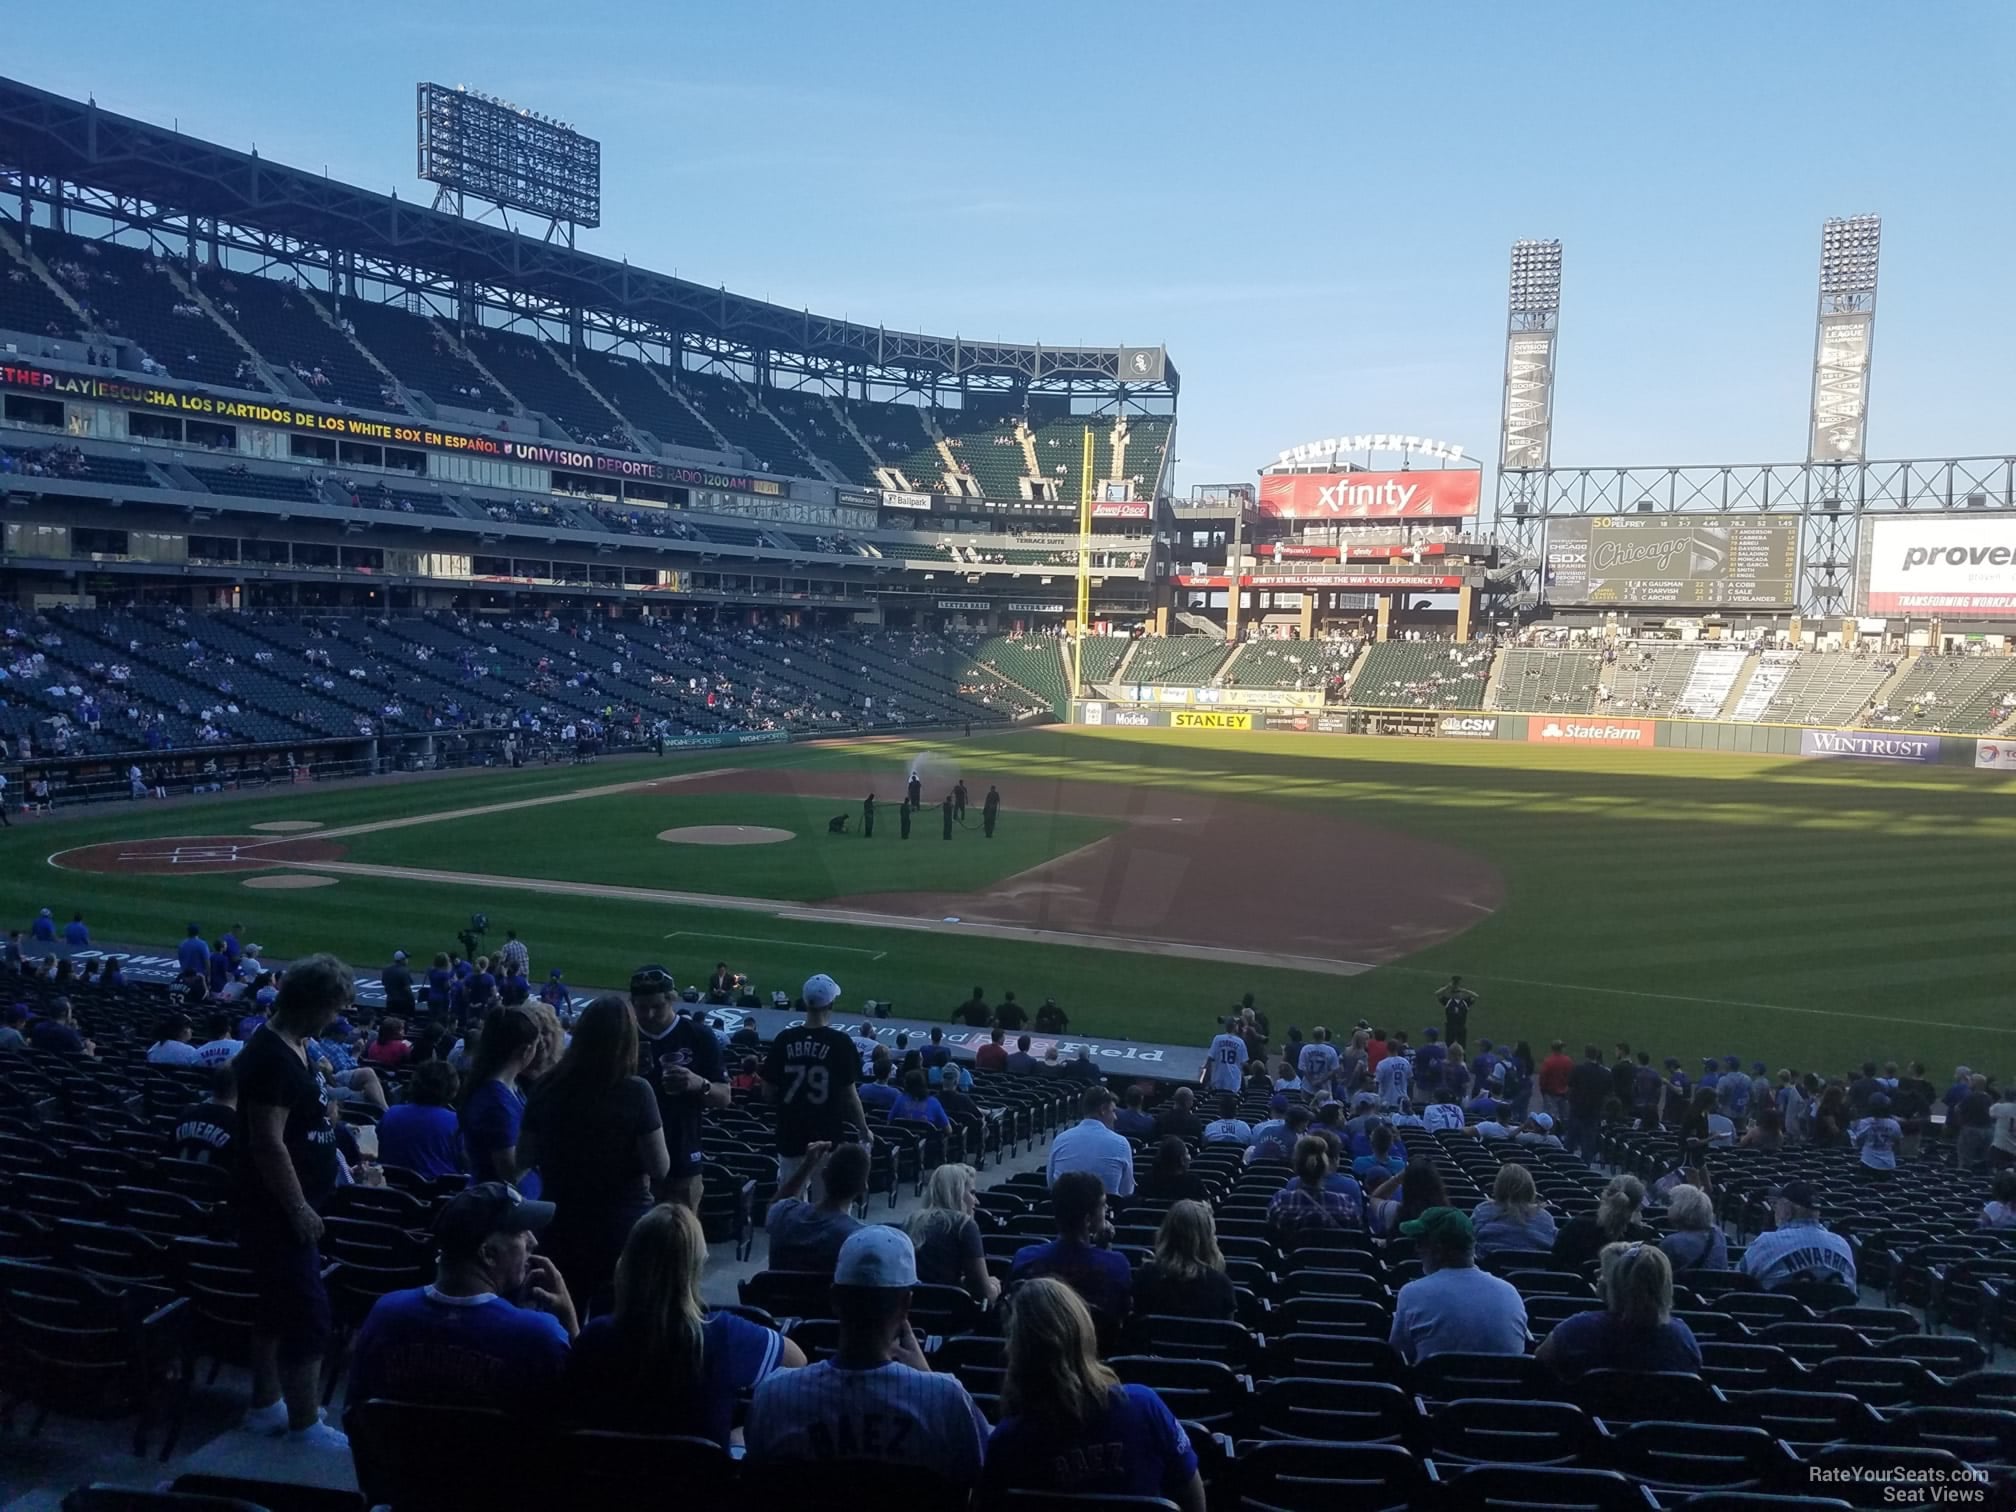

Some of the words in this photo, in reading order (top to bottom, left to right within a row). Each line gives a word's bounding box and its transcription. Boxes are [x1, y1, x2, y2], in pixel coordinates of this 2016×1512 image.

[1826, 330, 1864, 338] LEAGUE
[99, 382, 178, 408] ESCUCHA
[181, 395, 213, 412] LOS
[216, 400, 292, 424] PARTIDOS
[295, 412, 315, 427] DE
[318, 415, 345, 431] LOS
[349, 419, 391, 439] WHITE
[394, 427, 421, 442] SOX
[424, 432, 442, 445] EN
[445, 435, 500, 454] ESPAÑOL
[597, 456, 663, 479] DEPORTES
[667, 466, 701, 483] RADIO
[1278, 434, 1465, 464] FUNDAMENTALS
[897, 496, 927, 507] Ballpark
[1316, 479, 1418, 512] xfinity
[1093, 504, 1147, 517] Jewel-Osco
[1593, 517, 1611, 527] 50
[1611, 520, 1646, 528] PELFREY
[1016, 537, 1046, 545] TERRACE
[1549, 553, 1587, 563] SOX
[1592, 537, 1691, 571] Chicago
[1302, 576, 1332, 584] CHANGE
[1899, 596, 1969, 607] TRANSFORMING
[1115, 713, 1149, 726] Modelo
[1176, 714, 1247, 728] STANLEY
[1461, 718, 1496, 731] CSN
[1811, 732, 1928, 757] WINTRUST
[786, 1041, 831, 1060] ABREU
[1221, 1049, 1236, 1065] 18
[784, 1065, 830, 1105] 79
